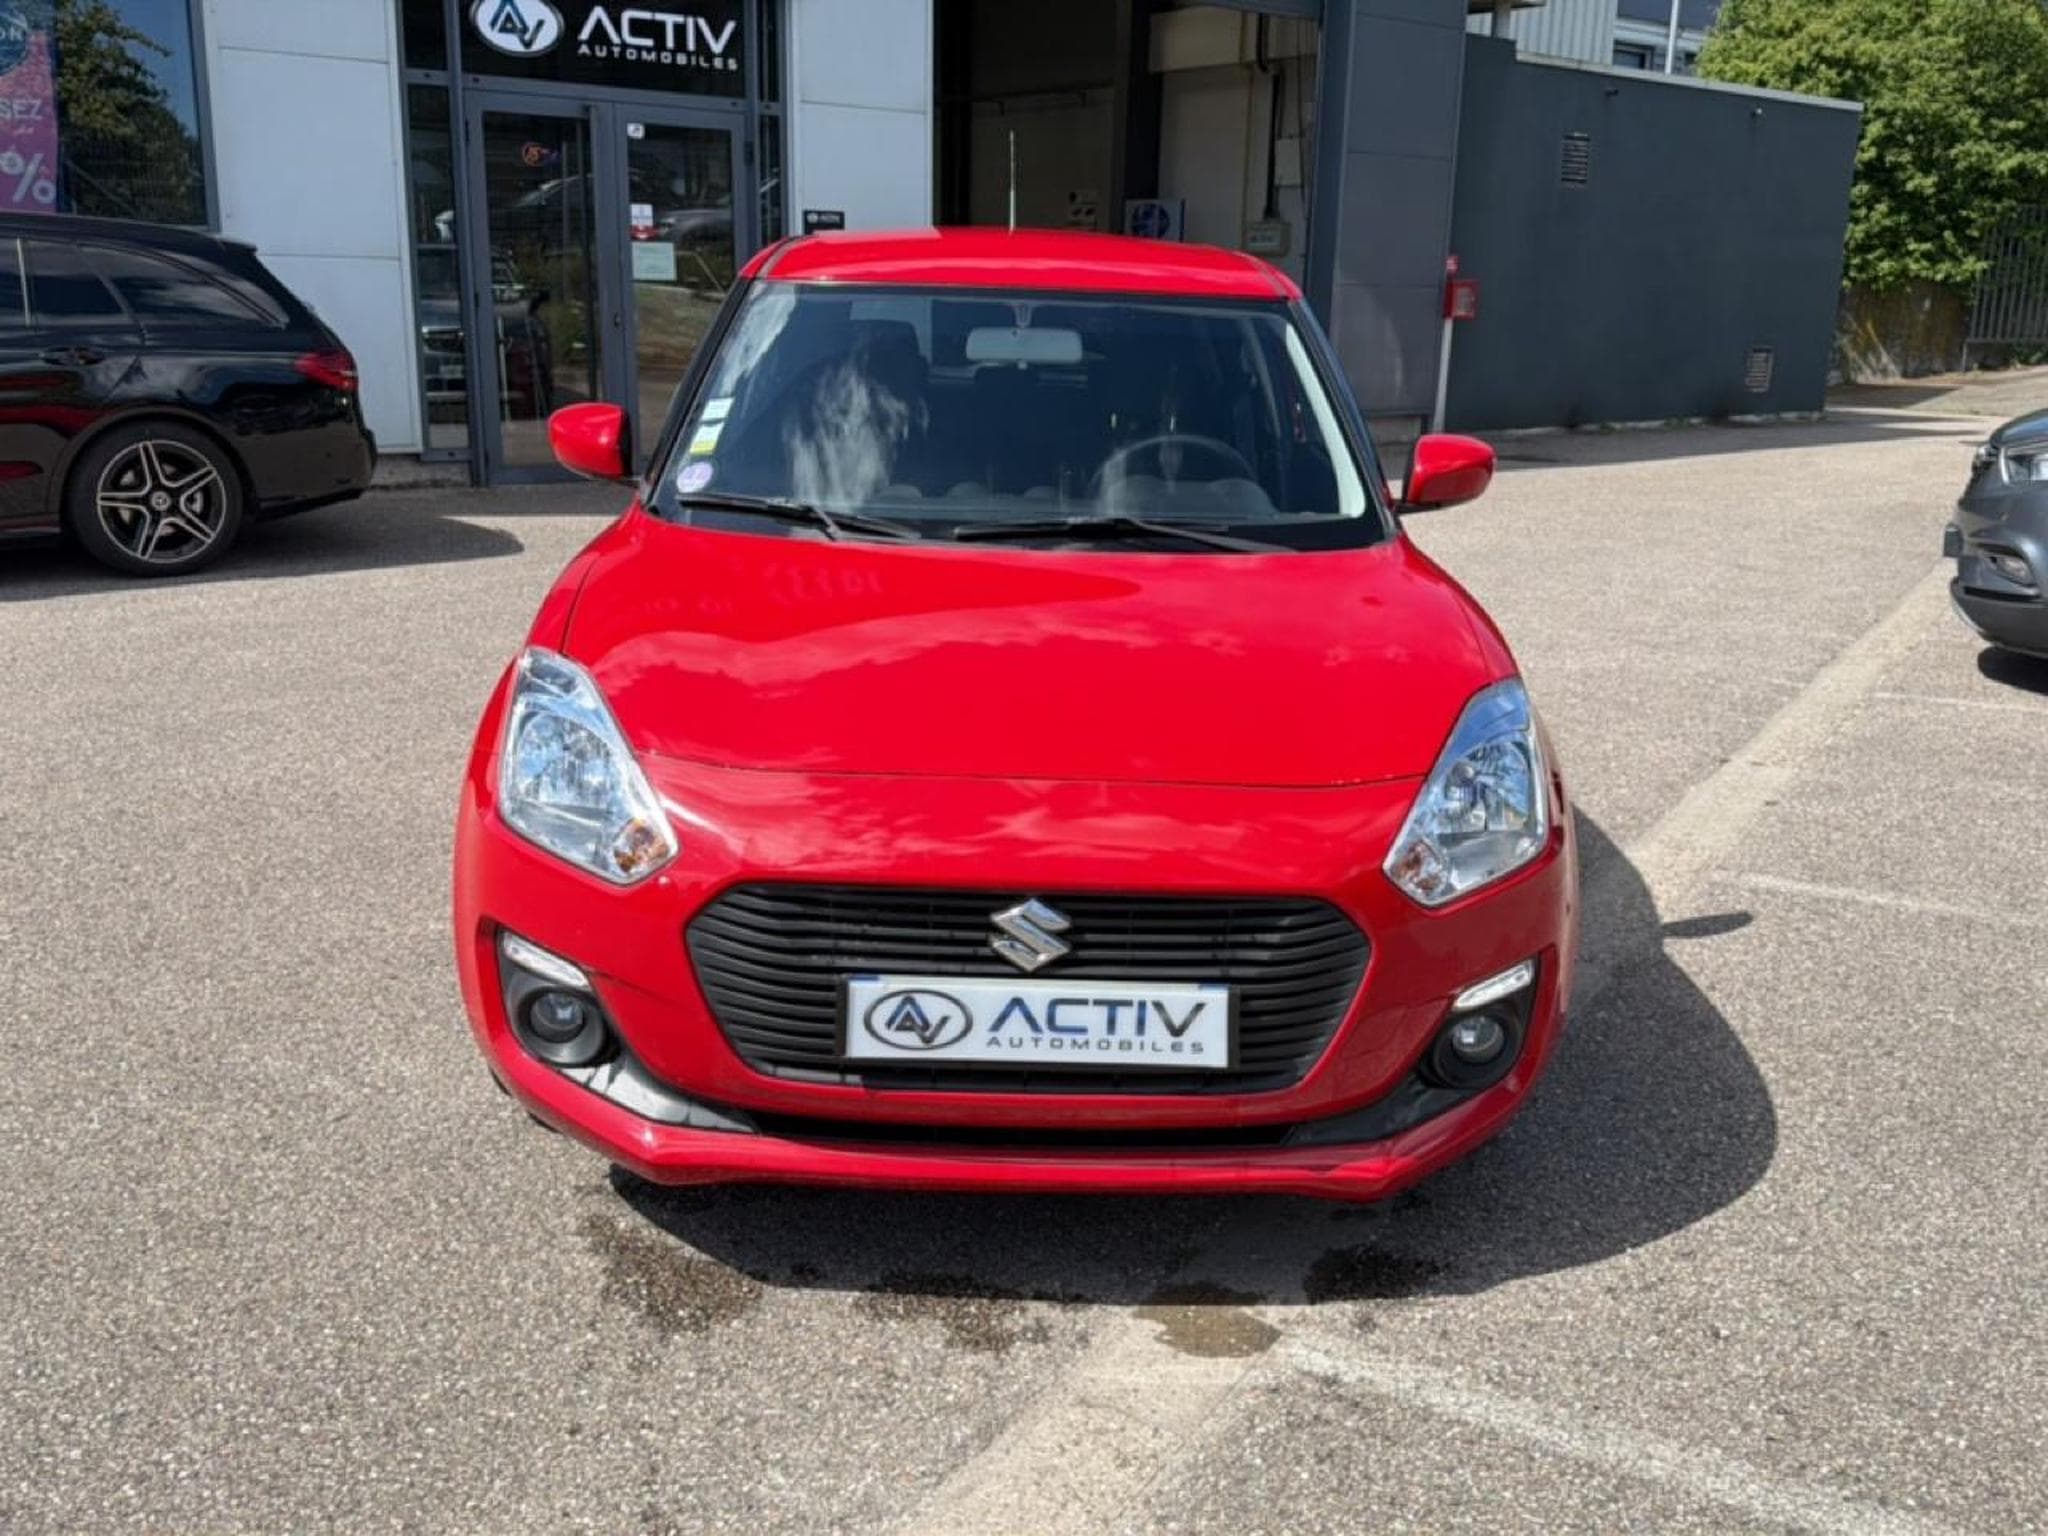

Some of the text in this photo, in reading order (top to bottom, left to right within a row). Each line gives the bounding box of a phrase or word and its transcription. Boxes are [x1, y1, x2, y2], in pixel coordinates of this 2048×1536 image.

[578, 5, 737, 54] ACTIV
[577, 43, 739, 71] AUTOMOBILES
[987, 995, 1207, 1038] ACTIV
[985, 1035, 1205, 1054] AUTOMOBILES
